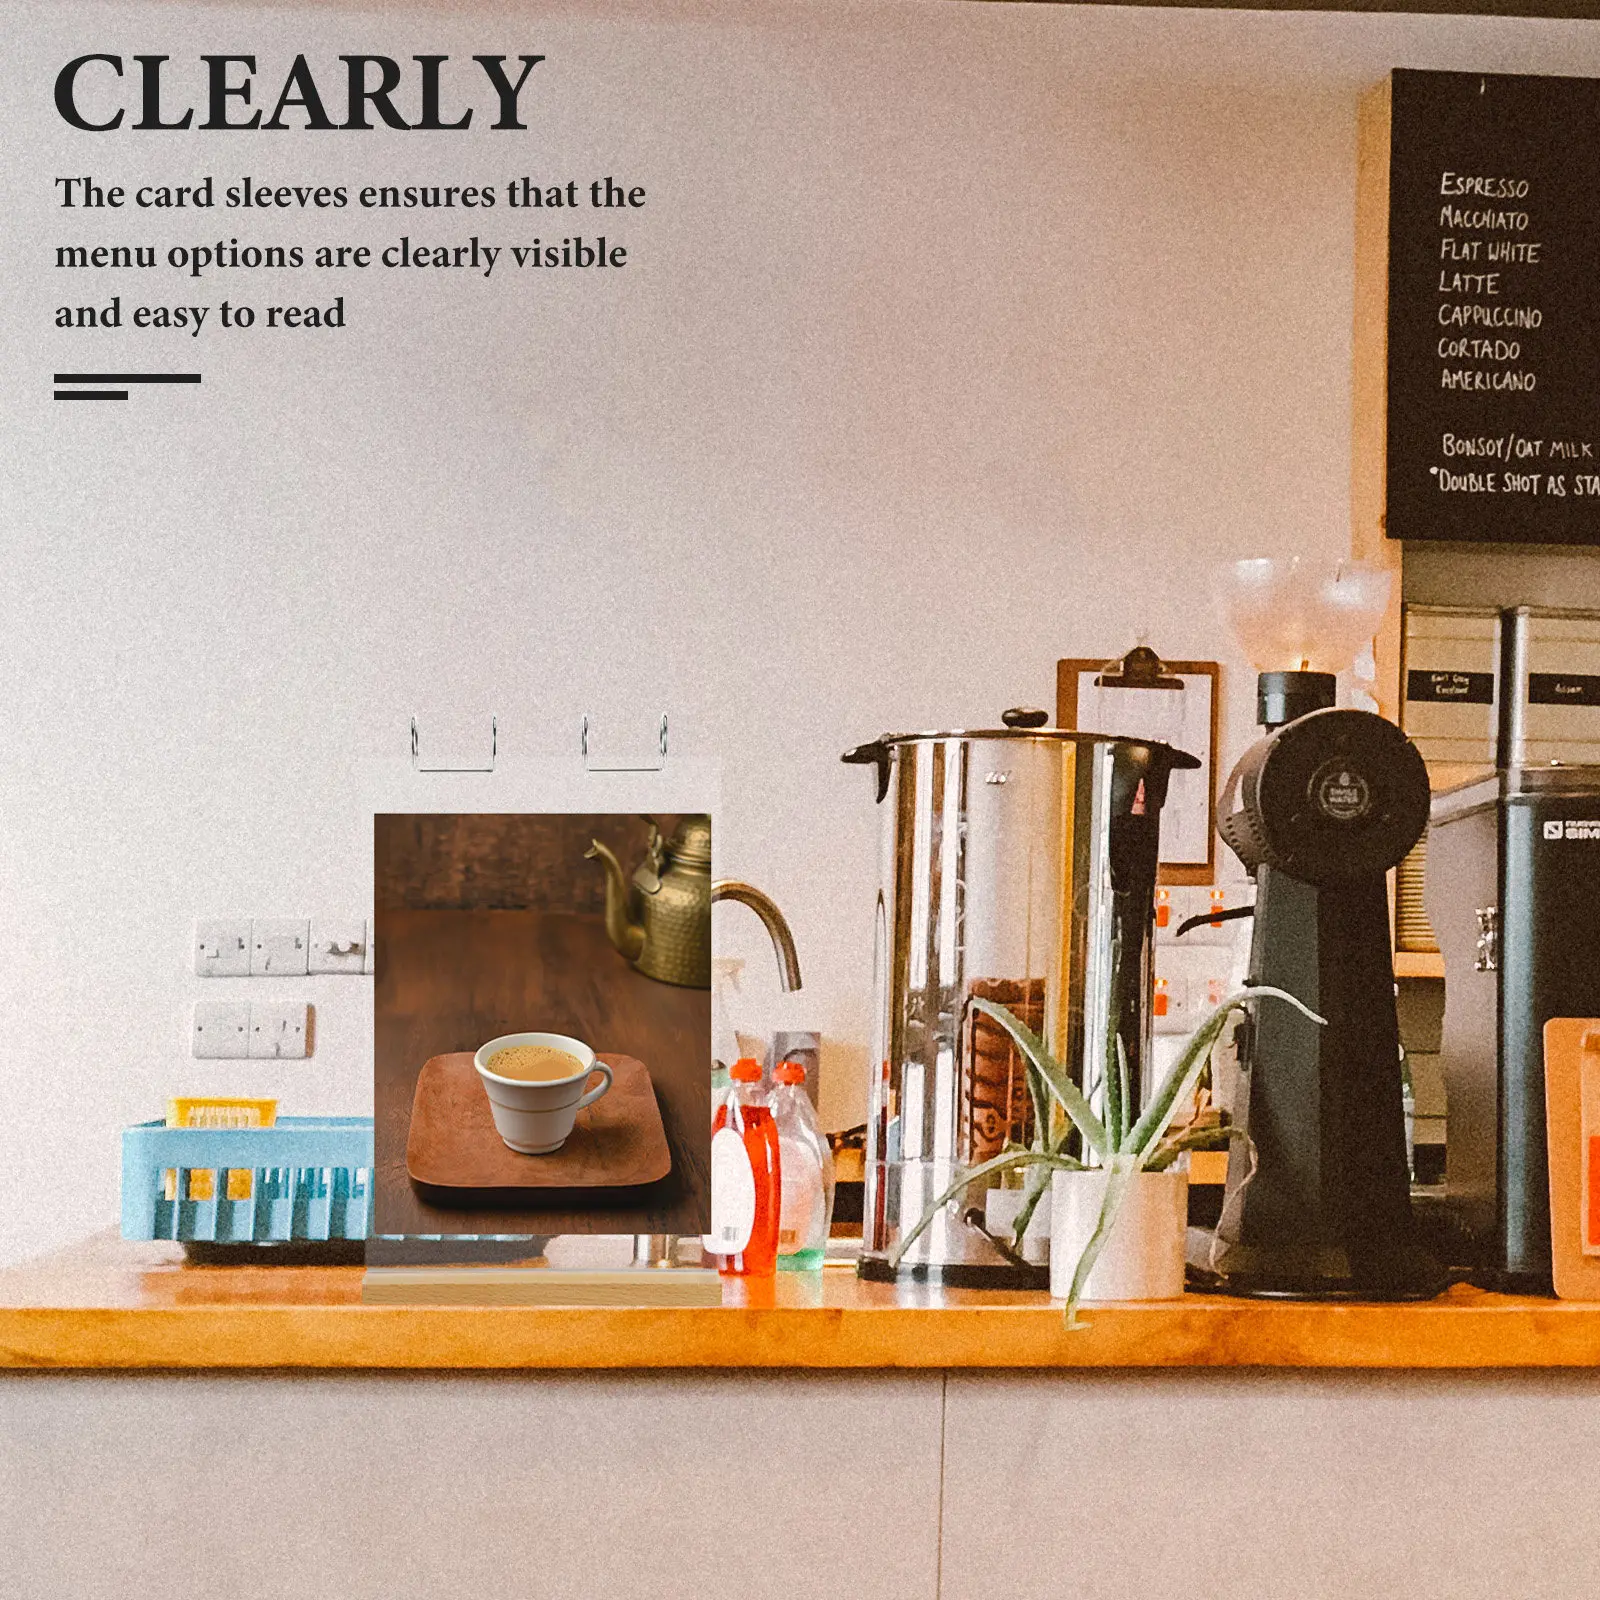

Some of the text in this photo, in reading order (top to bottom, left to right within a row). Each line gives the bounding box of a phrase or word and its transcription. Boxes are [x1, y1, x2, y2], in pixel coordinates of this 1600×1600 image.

[1440, 171, 1529, 199] ESPRESSO
[1440, 204, 1529, 231] MACCHIATO
[1440, 237, 1542, 264] FLAT WHITE
[1438, 270, 1500, 295] LATTE
[1438, 303, 1543, 330] CAPPUCCINO
[1437, 337, 1521, 361] CORTADO
[1441, 368, 1537, 392] AMERICANO
[1549, 441, 1593, 460] MILK
[1502, 471, 1542, 495] SHOT
[1547, 474, 1567, 497] AS
